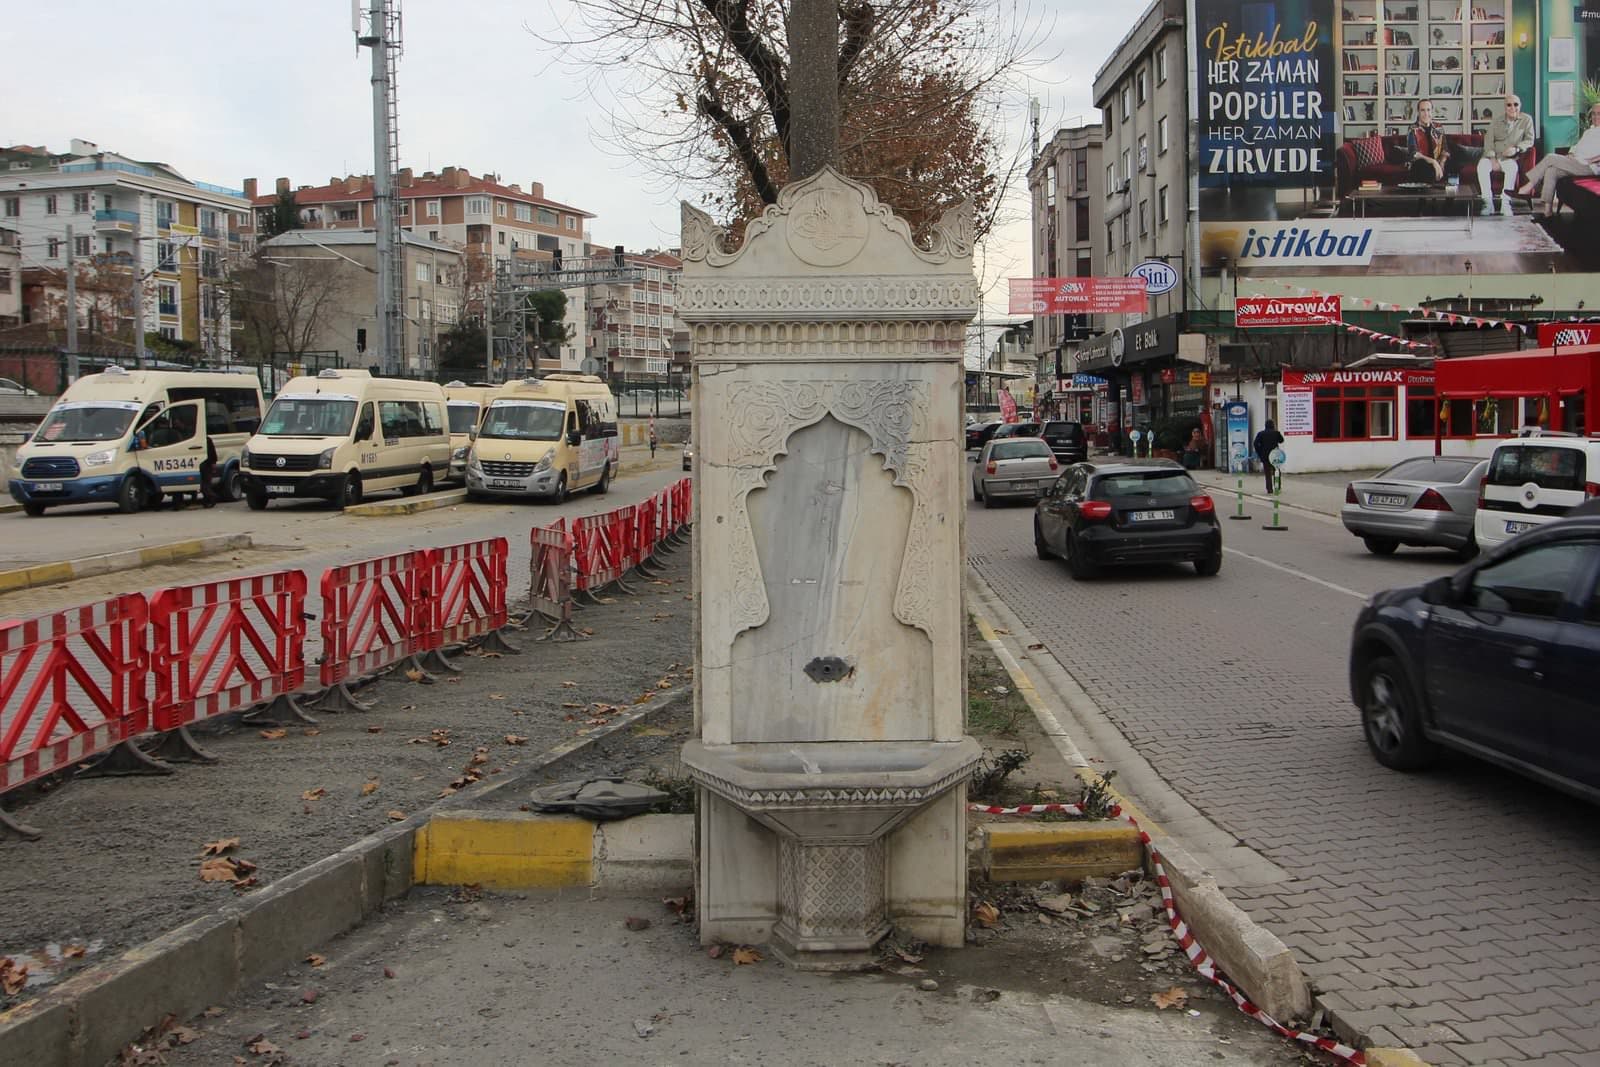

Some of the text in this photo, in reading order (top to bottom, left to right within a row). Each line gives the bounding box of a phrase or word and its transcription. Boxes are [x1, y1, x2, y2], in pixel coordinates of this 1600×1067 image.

[1205, 21, 1318, 63] İstikbal
[1208, 59, 1319, 85] HER ZAMAN
[1208, 91, 1323, 120] POPÜLER
[1208, 126, 1321, 145] HER ZAMAN
[1208, 144, 1323, 174] ZİRVEDE
[1240, 228, 1373, 258] istikbal
[1138, 268, 1168, 287] Sini
[1266, 302, 1336, 315] AUTOWAX
[1136, 334, 1142, 350] Et
[1333, 371, 1403, 382] AUTOWAX
